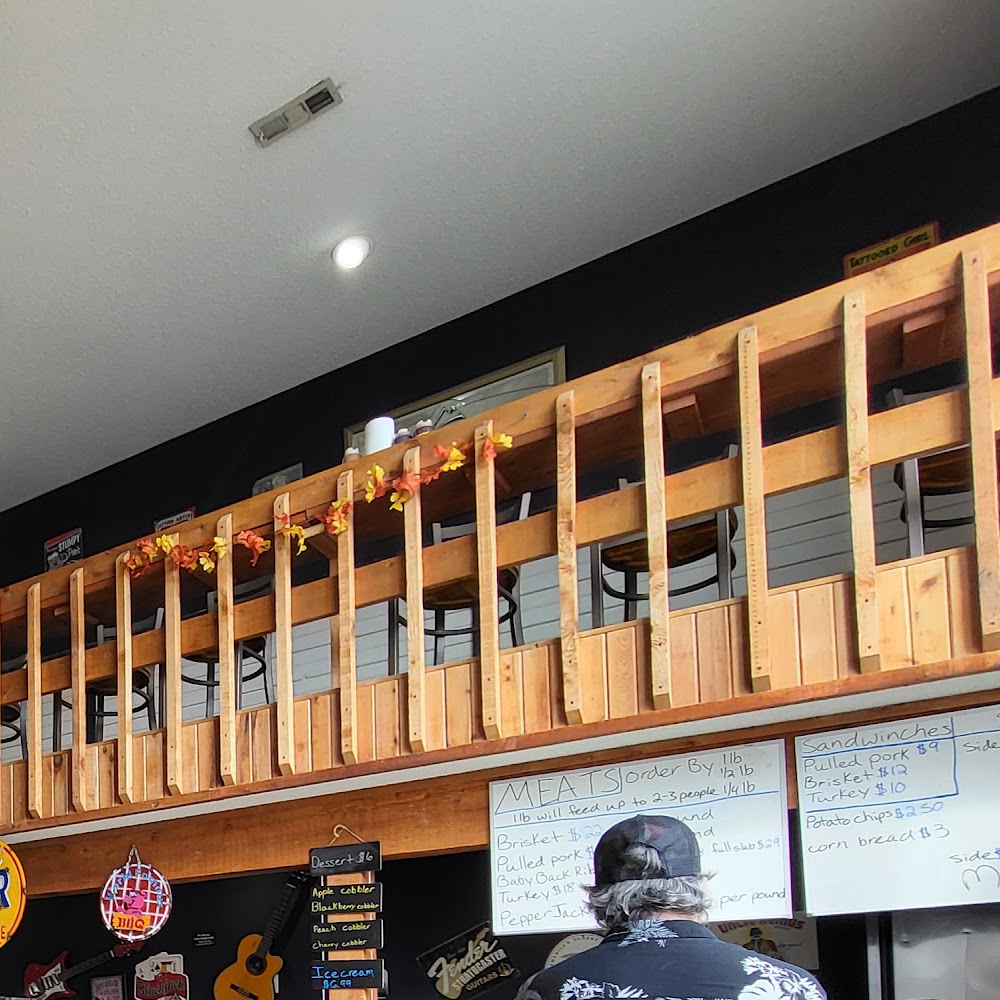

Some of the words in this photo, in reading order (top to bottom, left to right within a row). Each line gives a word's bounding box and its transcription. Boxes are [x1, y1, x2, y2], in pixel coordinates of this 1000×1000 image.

[58, 534, 81, 553] STUMPY
[803, 756, 862, 772] Pulled
[870, 749, 909, 769] pork
[916, 741, 938, 755] $9
[494, 769, 620, 815] MEATS
[688, 758, 714, 776] By
[804, 771, 874, 789] Brisket
[877, 764, 907, 778] $12
[807, 787, 870, 803] Turkey
[875, 782, 906, 797] $10
[537, 808, 561, 820] will
[568, 802, 600, 816] feed
[606, 800, 625, 811] up
[632, 797, 647, 807] to
[497, 830, 565, 851] Brisket
[807, 839, 849, 853] corn
[858, 829, 915, 846] bread
[919, 823, 951, 839] $3
[311, 854, 354, 869] Dessert
[356, 851, 374, 864] $6
[497, 855, 546, 872] Pulled
[551, 849, 584, 867] pork
[497, 873, 533, 888] Baby
[536, 869, 571, 884] Back
[312, 887, 335, 900] Apple
[340, 885, 376, 895] cobbler
[498, 889, 550, 904] Turkey
[551, 882, 575, 896] $18
[720, 894, 747, 910] per
[752, 888, 786, 904] pound
[117, 917, 145, 929] BBQ
[313, 924, 337, 934] Peach
[341, 922, 371, 932] cobbler
[341, 939, 367, 948] cobbler
[427, 939, 499, 995] Fender
[452, 948, 508, 991] STRATOCASTER
[465, 970, 499, 991] GUITARS
